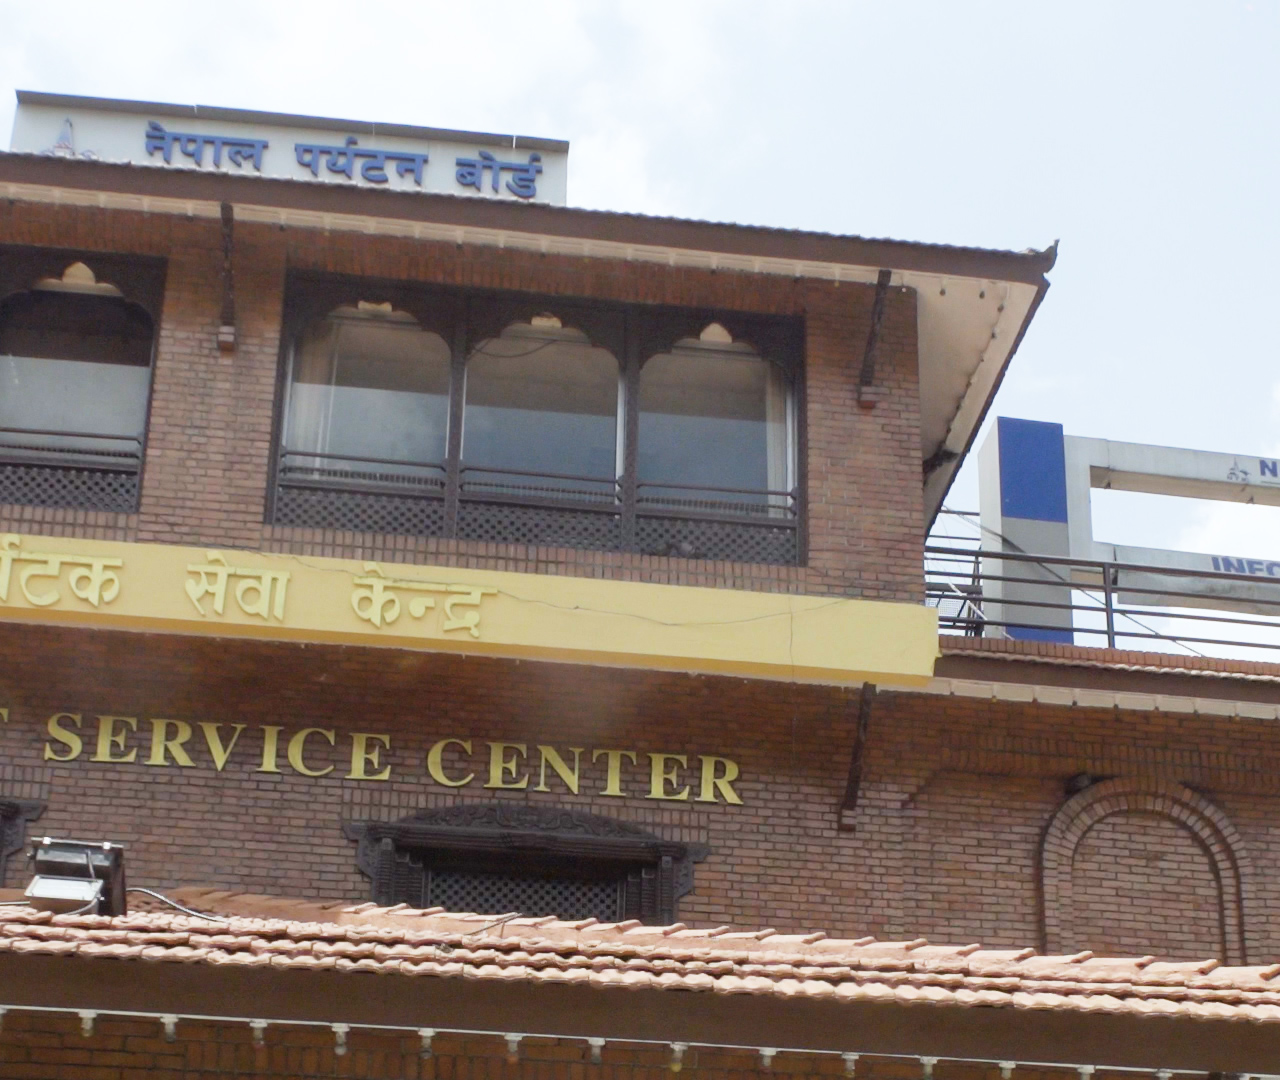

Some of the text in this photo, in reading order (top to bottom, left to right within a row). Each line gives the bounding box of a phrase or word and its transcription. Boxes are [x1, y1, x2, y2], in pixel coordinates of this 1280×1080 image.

[144, 121, 543, 199] नेपाल पर्यटन बोर्ड
[185, 550, 291, 622] सेवा
[351, 561, 498, 638] केन्द्र
[44, 712, 392, 781] SERVICE
[426, 738, 744, 806] CENTER
